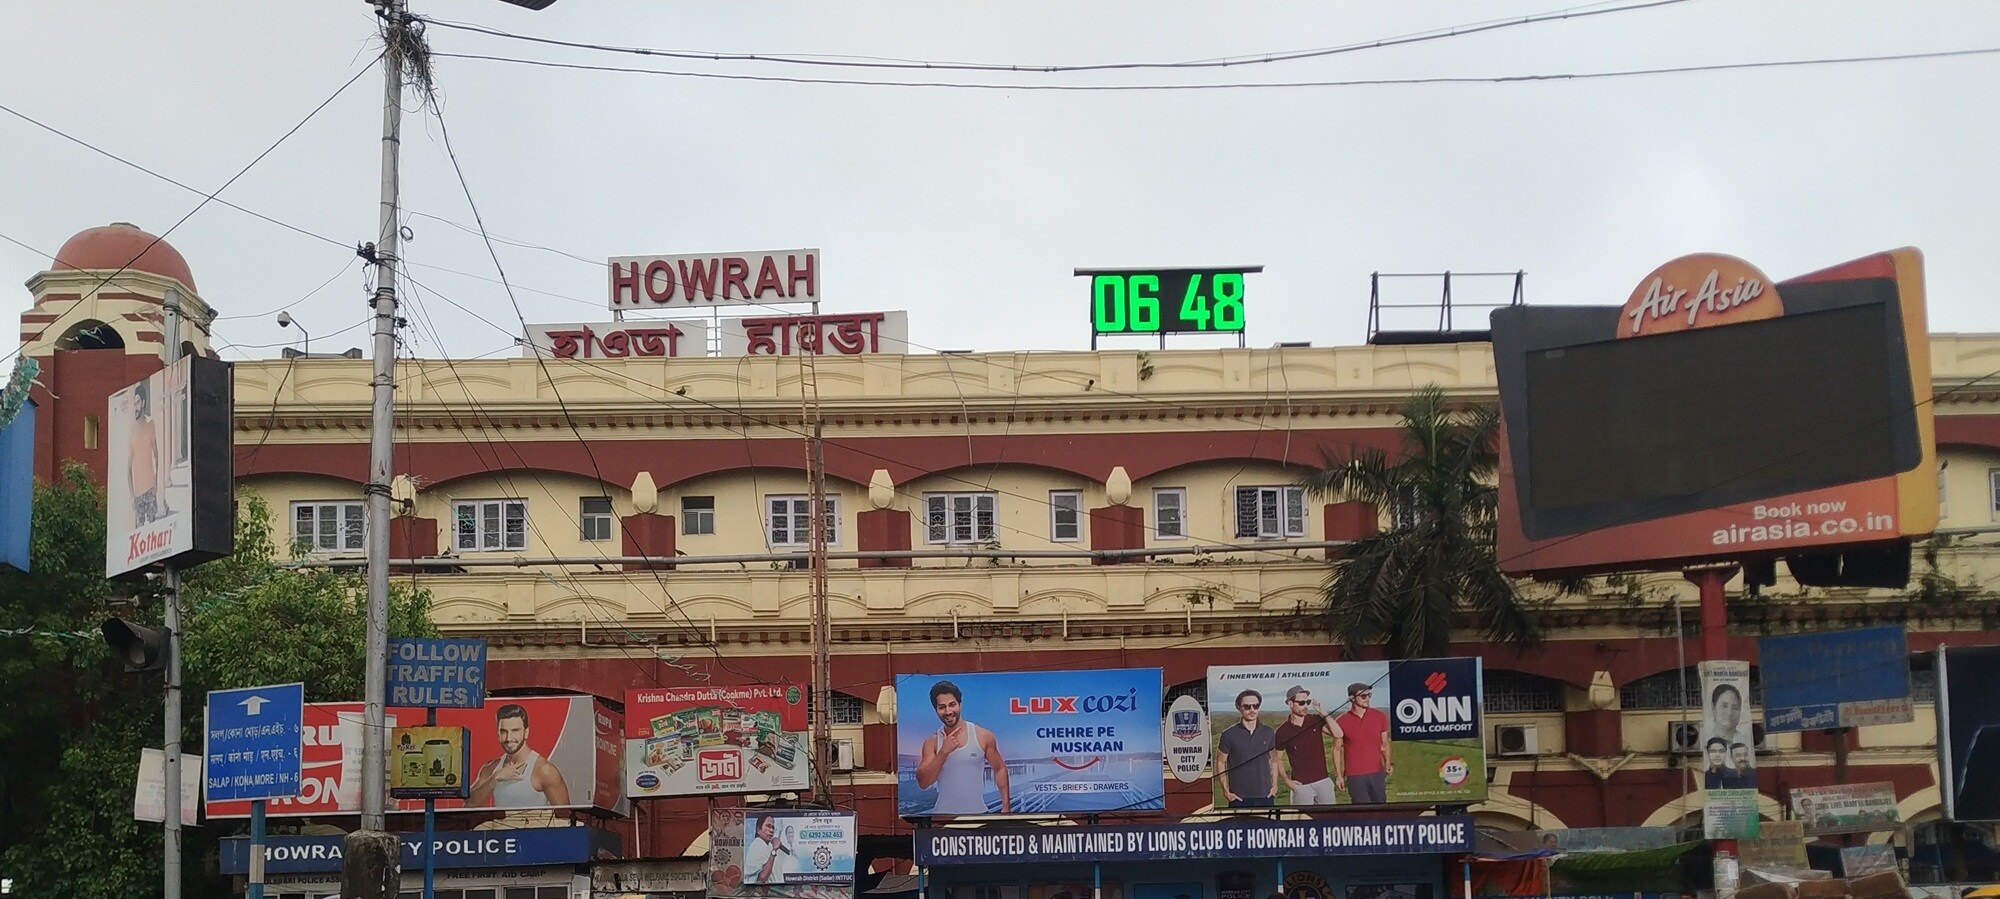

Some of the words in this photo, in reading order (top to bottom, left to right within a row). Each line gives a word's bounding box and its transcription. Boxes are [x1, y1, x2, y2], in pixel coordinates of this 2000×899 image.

[612, 254, 815, 303] HOWRAH
[1094, 274, 1160, 331] 06
[1179, 273, 1245, 331] 48
[1753, 503, 1802, 521] Book
[1806, 499, 1847, 517] now
[1712, 511, 1893, 546] airasia.co.in
[127, 523, 173, 566] Kothari
[387, 643, 482, 662] FOLLOW
[386, 664, 480, 685] TRAFFIC
[1227, 672, 1276, 680] INNERWEAR
[1282, 670, 1331, 678] ATHLEISURE
[393, 686, 468, 705] RULES
[637, 693, 665, 704] Krishna
[666, 692, 696, 703] Chandra
[696, 690, 718, 701] Dutta
[719, 688, 752, 701] (Cookme)
[753, 689, 768, 699] Pvt.
[1009, 695, 1080, 715] LUX
[1083, 686, 1138, 714] cozi
[1395, 695, 1472, 724] ONN
[303, 725, 342, 746] RU
[1036, 726, 1094, 738] CHEHRE
[1097, 726, 1115, 737] PE
[1399, 725, 1428, 734] TOTAL
[1428, 723, 1473, 733] COMFORT
[1051, 740, 1124, 753] MUSKAAN
[1173, 746, 1202, 754] HOWRAH
[1180, 755, 1196, 763] CITY
[1177, 764, 1199, 772] POLICE
[1446, 765, 1462, 773] 35+
[209, 777, 230, 788] SALAP
[255, 773, 275, 785] MORE
[279, 773, 289, 784] NH
[1034, 783, 1057, 791] VESTS
[1062, 783, 1088, 791] BRIEFS
[1093, 782, 1129, 790] DRAWERS
[932, 834, 1024, 857] CONSTRUCTED
[1028, 834, 1039, 855] &
[1042, 832, 1123, 855] MAINTAINED
[1127, 832, 1144, 852] BY
[1148, 830, 1186, 851] LIONS
[1190, 829, 1223, 850] CLUB
[1227, 829, 1243, 849] OF
[1247, 827, 1305, 849] HOWRAH
[1308, 827, 1320, 847] &
[1323, 825, 1381, 848] HOWRAH
[1384, 824, 1415, 846] CITY
[1418, 823, 1465, 844] POLICE
[263, 844, 343, 861] HOWRA
[433, 839, 516, 855] POLICE
[298, 876, 324, 884] POLICE
[520, 870, 546, 878] CAMP
